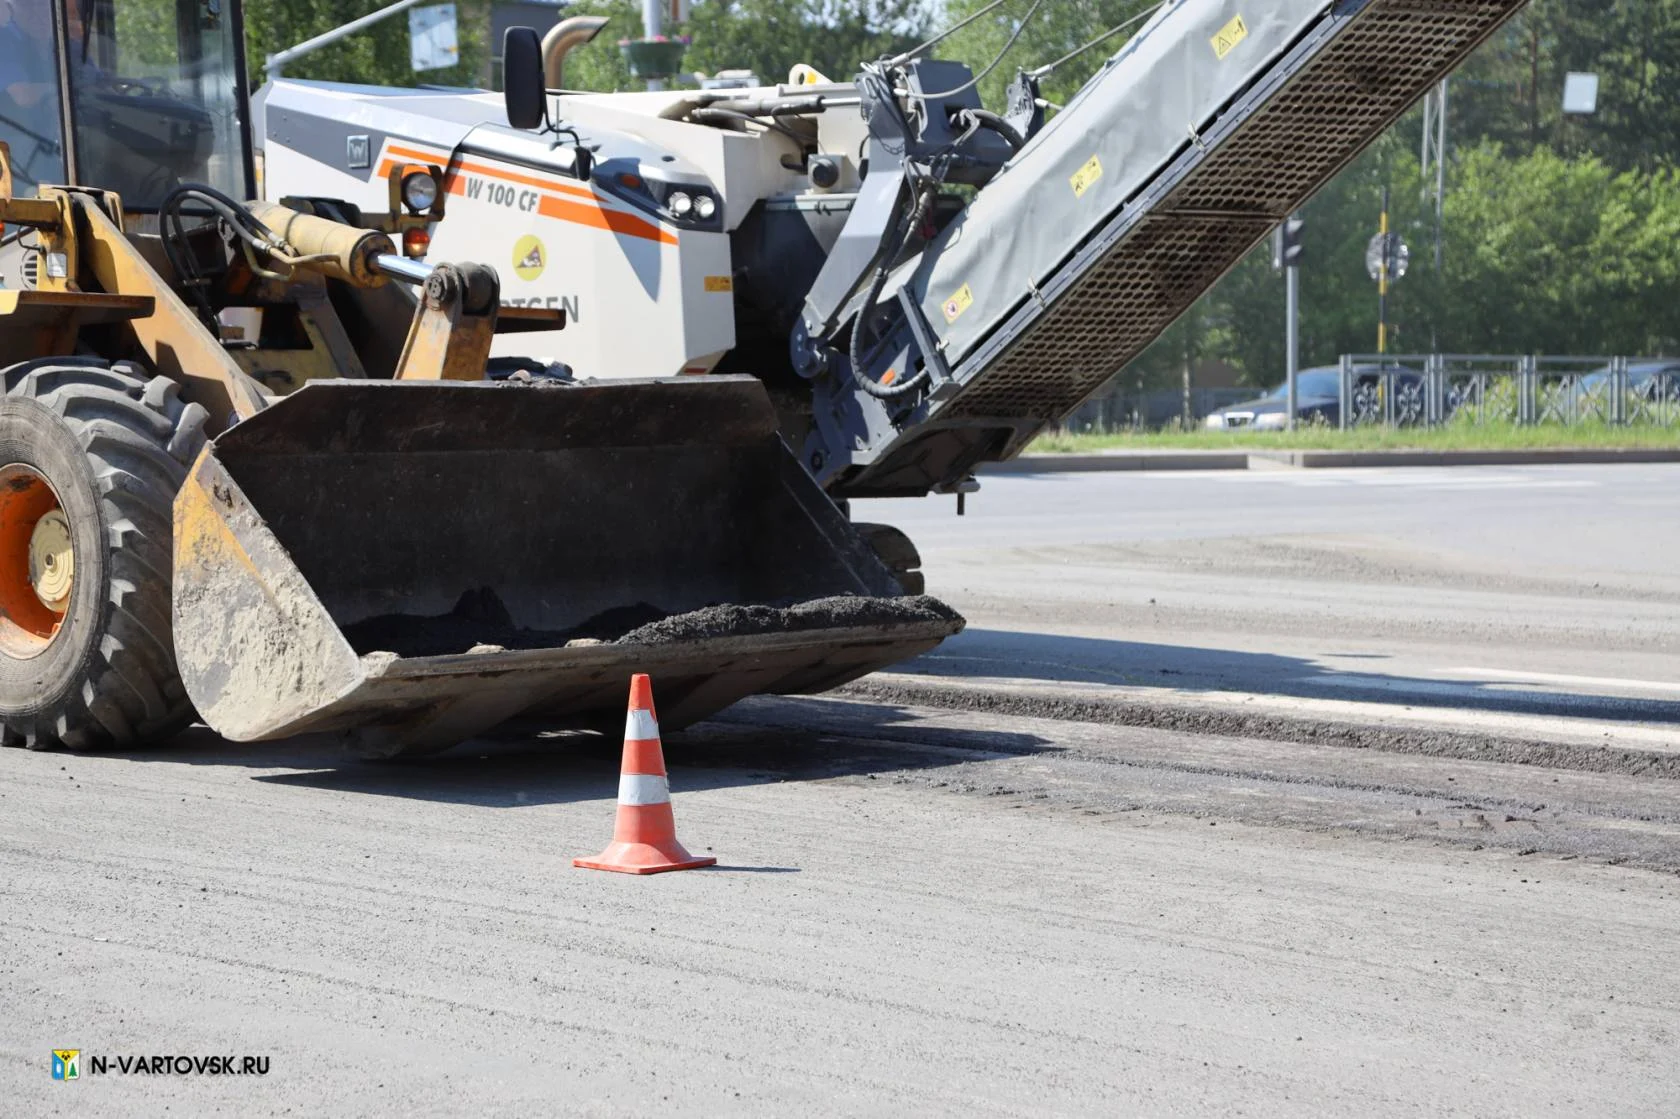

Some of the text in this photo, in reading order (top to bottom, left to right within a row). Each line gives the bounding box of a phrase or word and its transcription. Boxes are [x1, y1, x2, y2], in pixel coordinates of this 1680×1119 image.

[467, 177, 538, 212] W 100 CF
